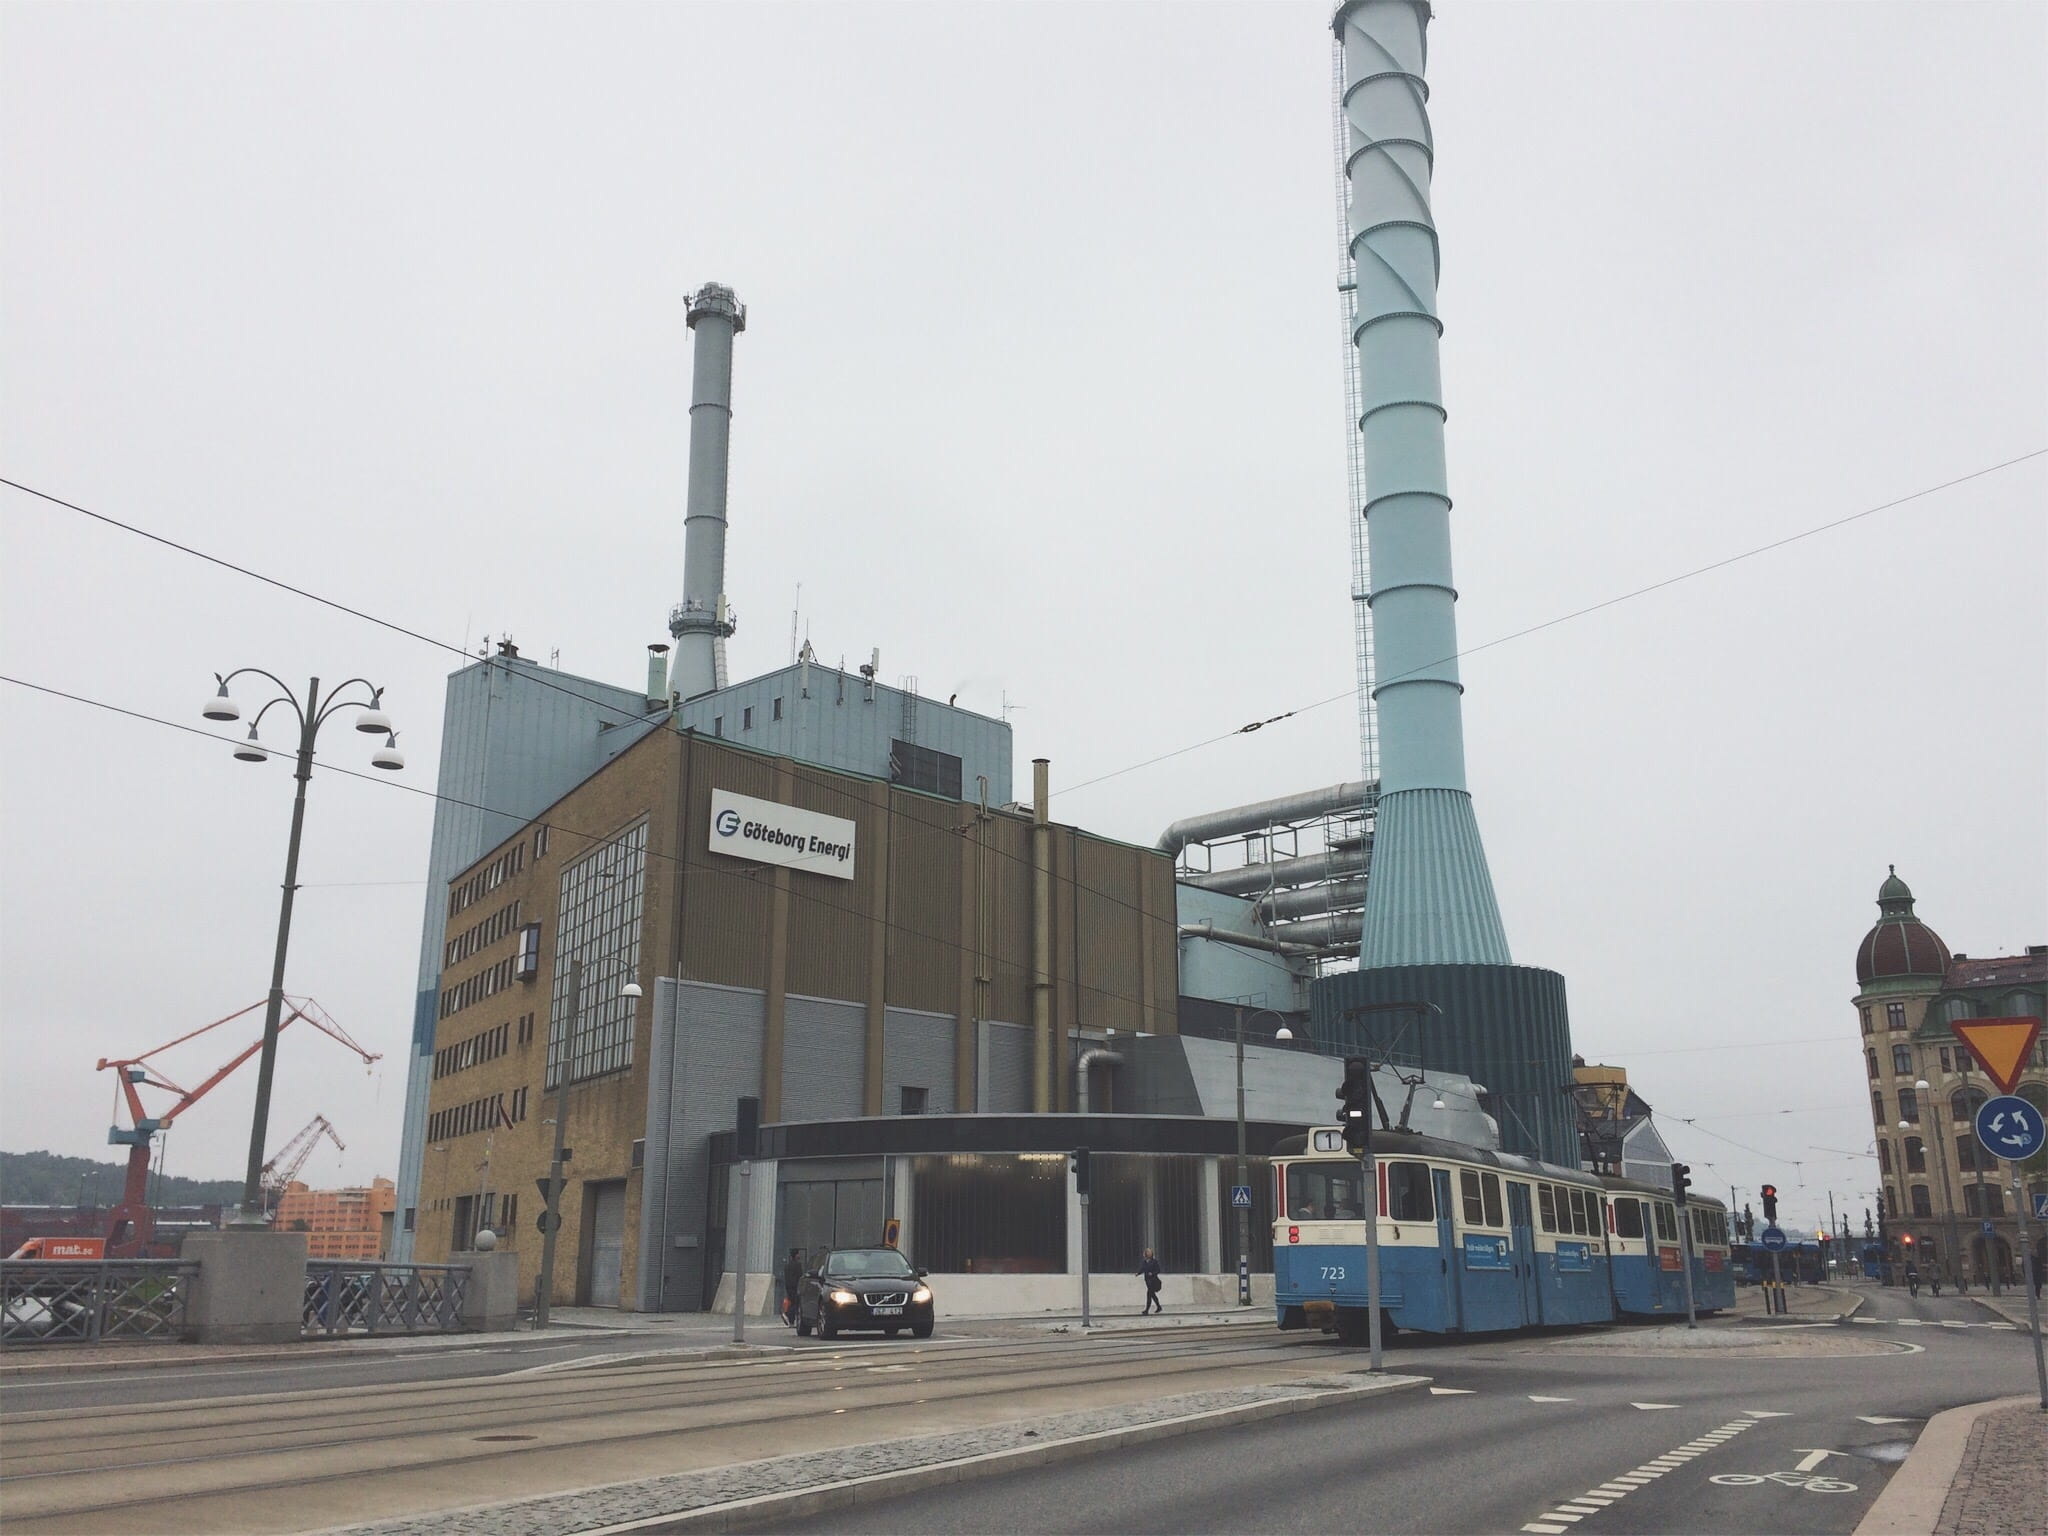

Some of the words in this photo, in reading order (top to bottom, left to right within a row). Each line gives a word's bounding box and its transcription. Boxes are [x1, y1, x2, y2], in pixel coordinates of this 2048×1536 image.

[743, 821, 806, 853] Göteborg
[808, 835, 851, 861] Energi
[1325, 1132, 1332, 1149] 1
[1320, 1266, 1345, 1280] 723
